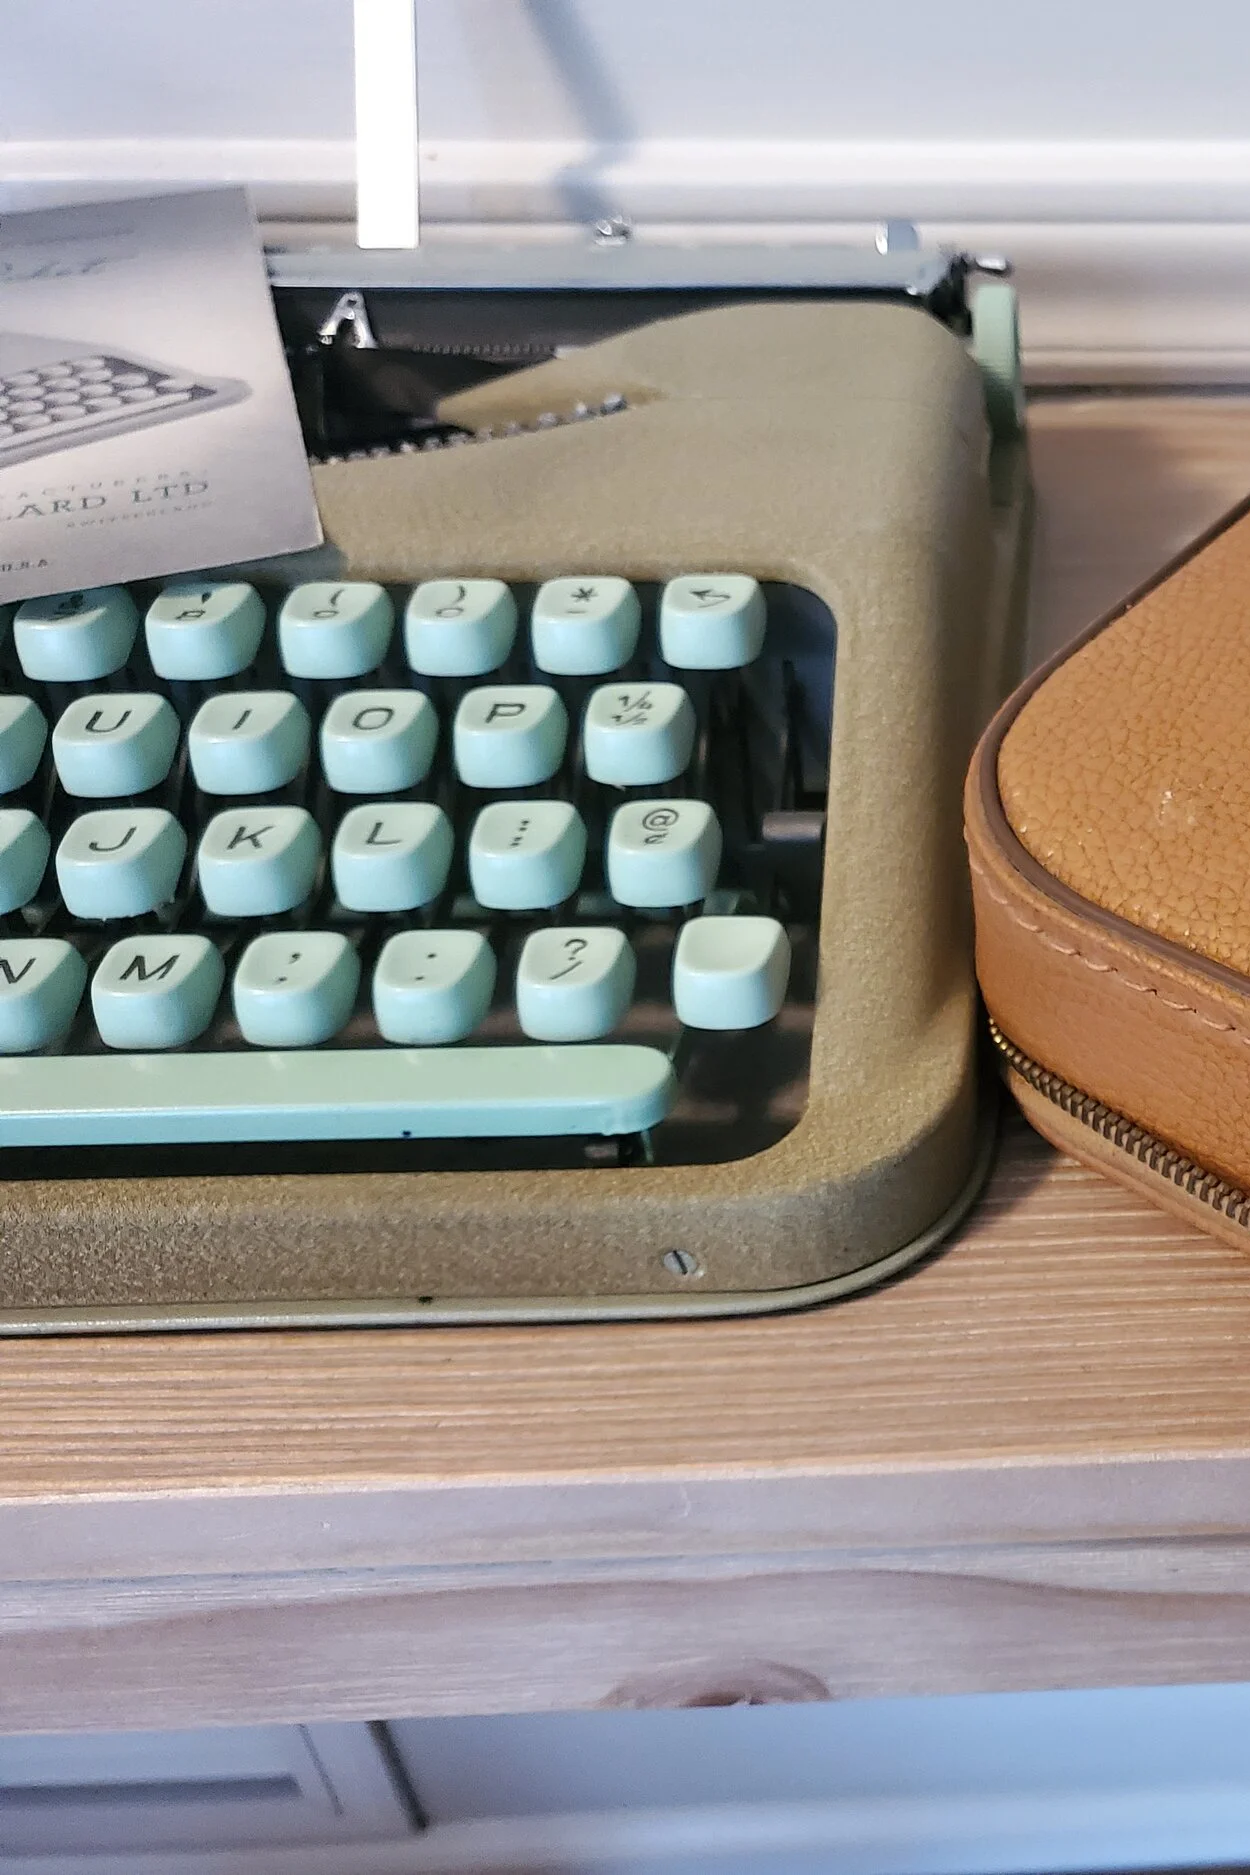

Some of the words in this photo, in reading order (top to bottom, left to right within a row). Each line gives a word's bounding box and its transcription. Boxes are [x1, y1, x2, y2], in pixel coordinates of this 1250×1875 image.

[2, 495, 106, 520] ARD
[132, 480, 208, 503] LTD
[85, 710, 132, 733] U
[231, 709, 253, 731] I
[352, 707, 394, 731] O
[485, 703, 526, 724] P
[88, 826, 137, 852] J
[227, 825, 274, 851] K
[365, 821, 402, 845] L
[642, 808, 680, 832] @
[119, 954, 179, 981] M
[564, 938, 588, 962] ?
